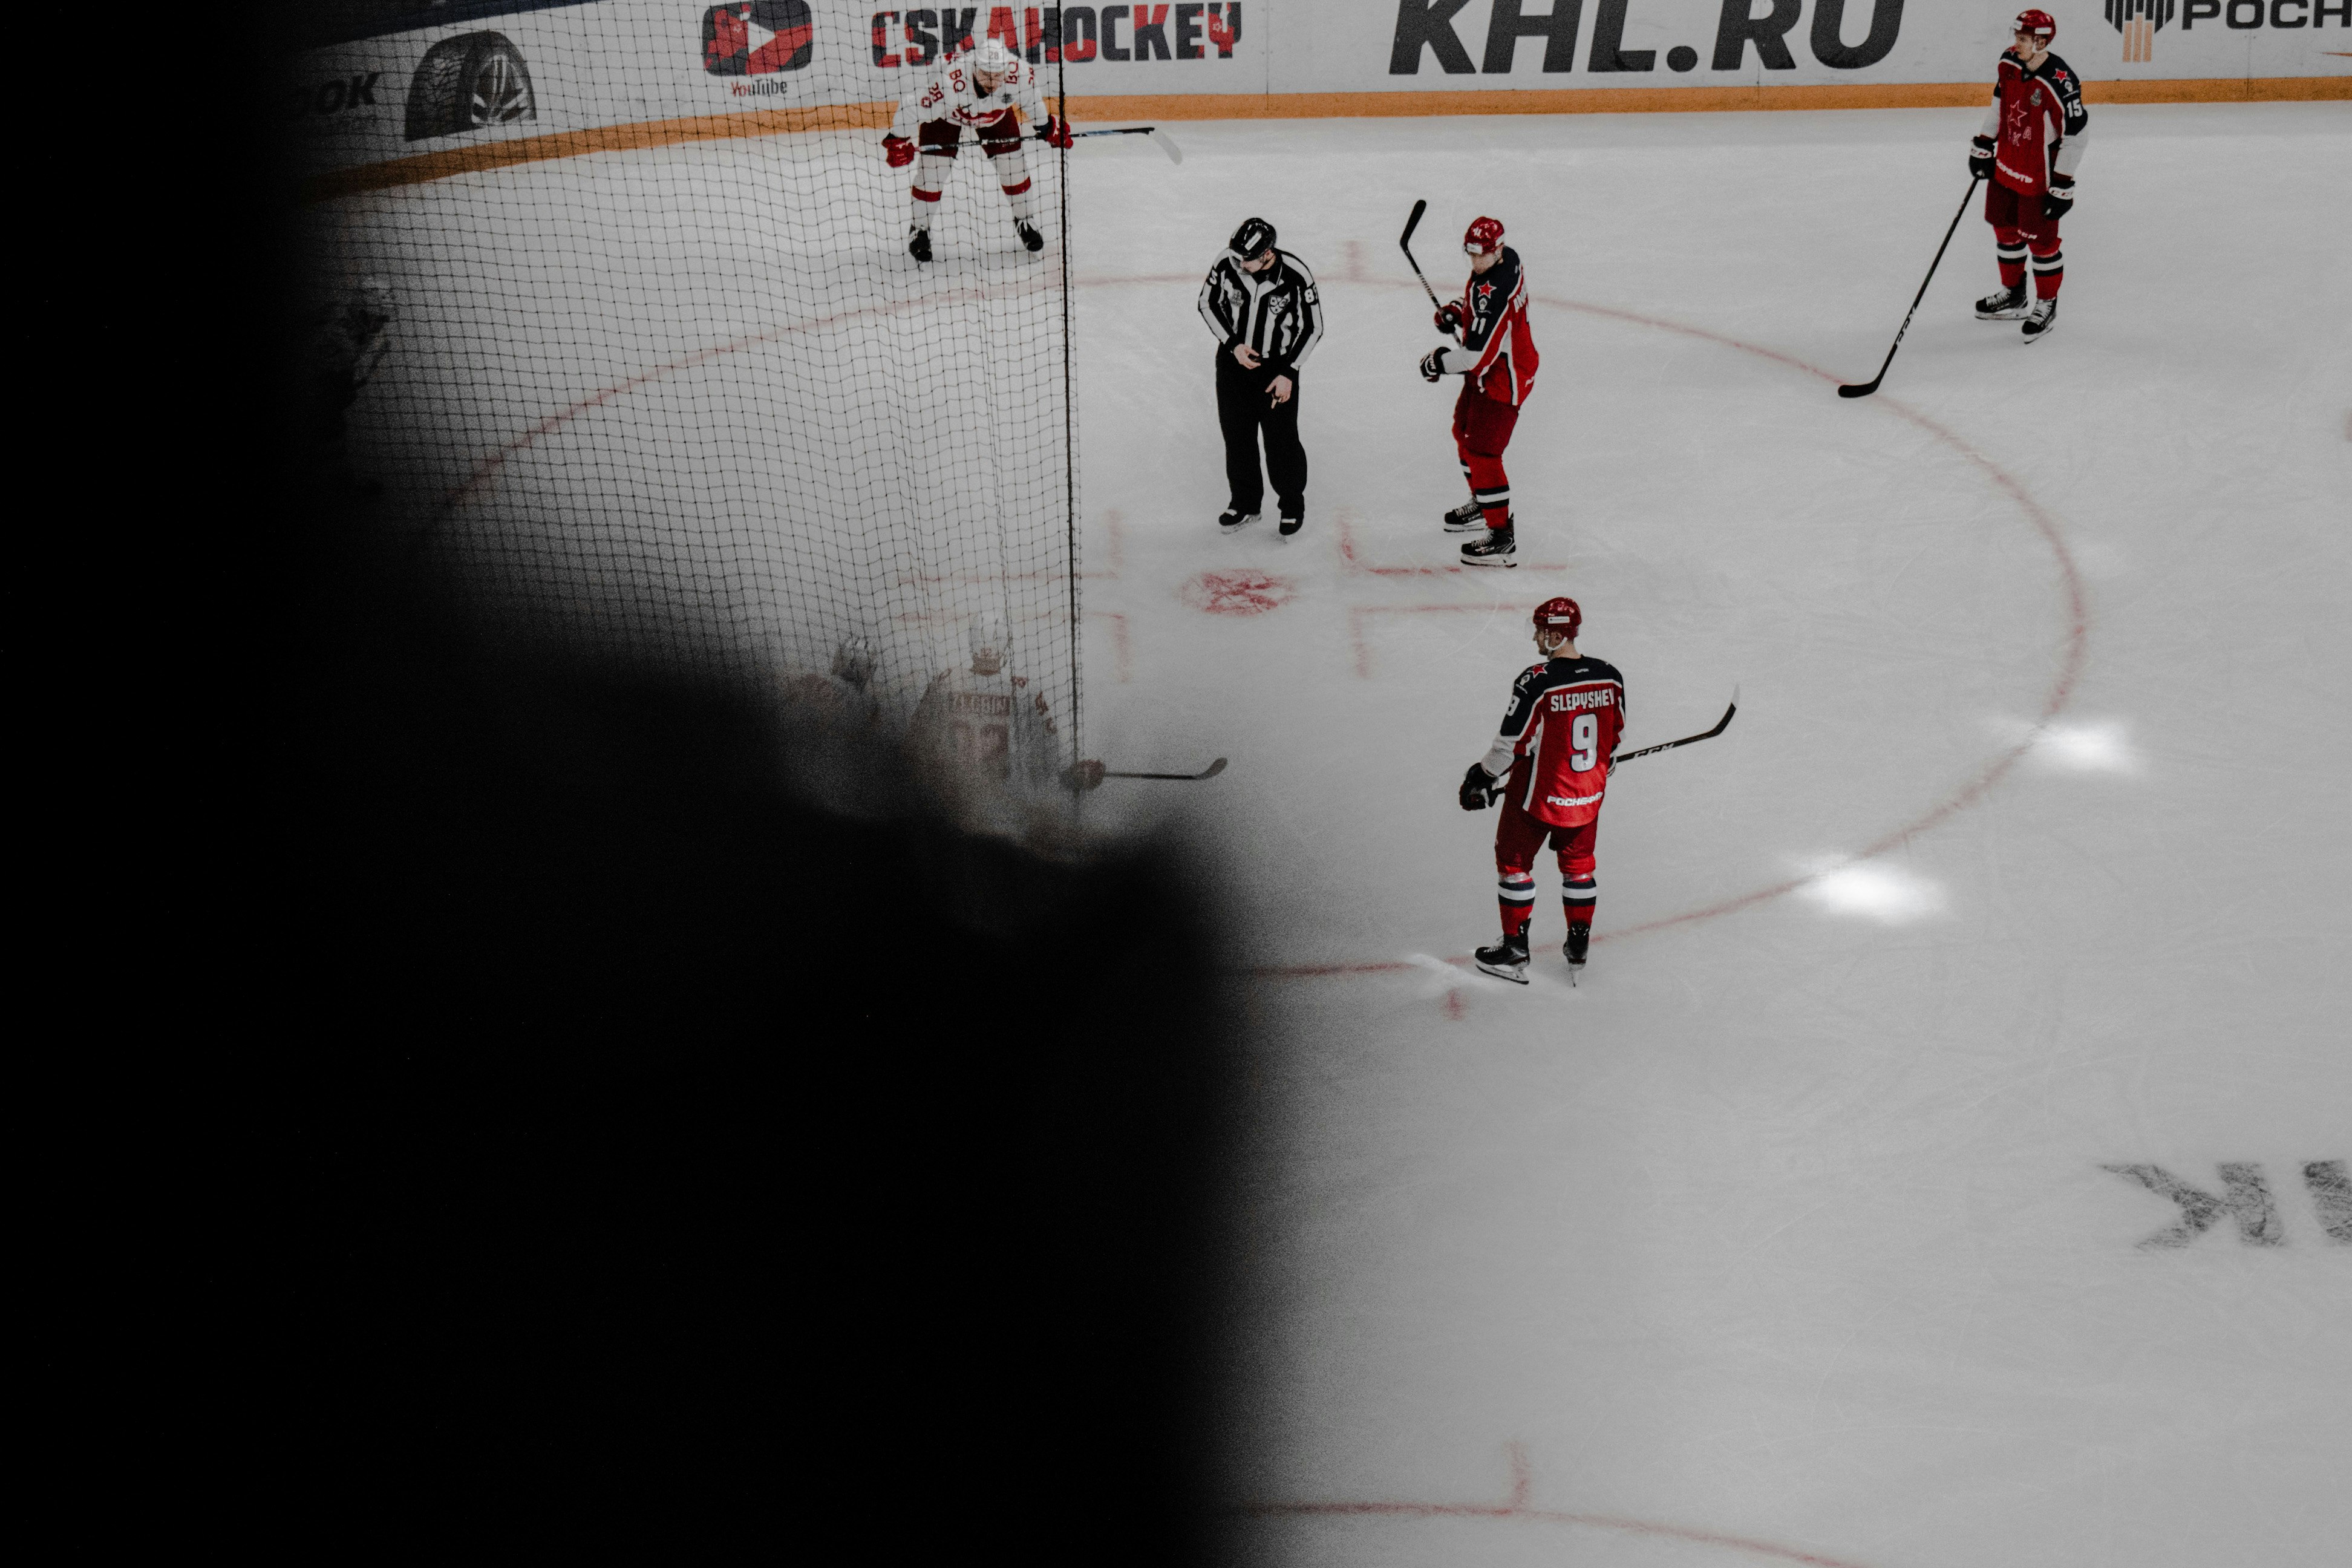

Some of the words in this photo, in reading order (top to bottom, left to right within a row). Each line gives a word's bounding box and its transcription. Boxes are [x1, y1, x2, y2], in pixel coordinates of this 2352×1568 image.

[1389, 0, 1906, 74] KHL.RU
[731, 78, 788, 97] YouTube
[2066, 99, 2083, 118] 15
[1471, 317, 1486, 335] 11
[1570, 713, 1598, 773] 9
[1633, 742, 1674, 759] CCM
